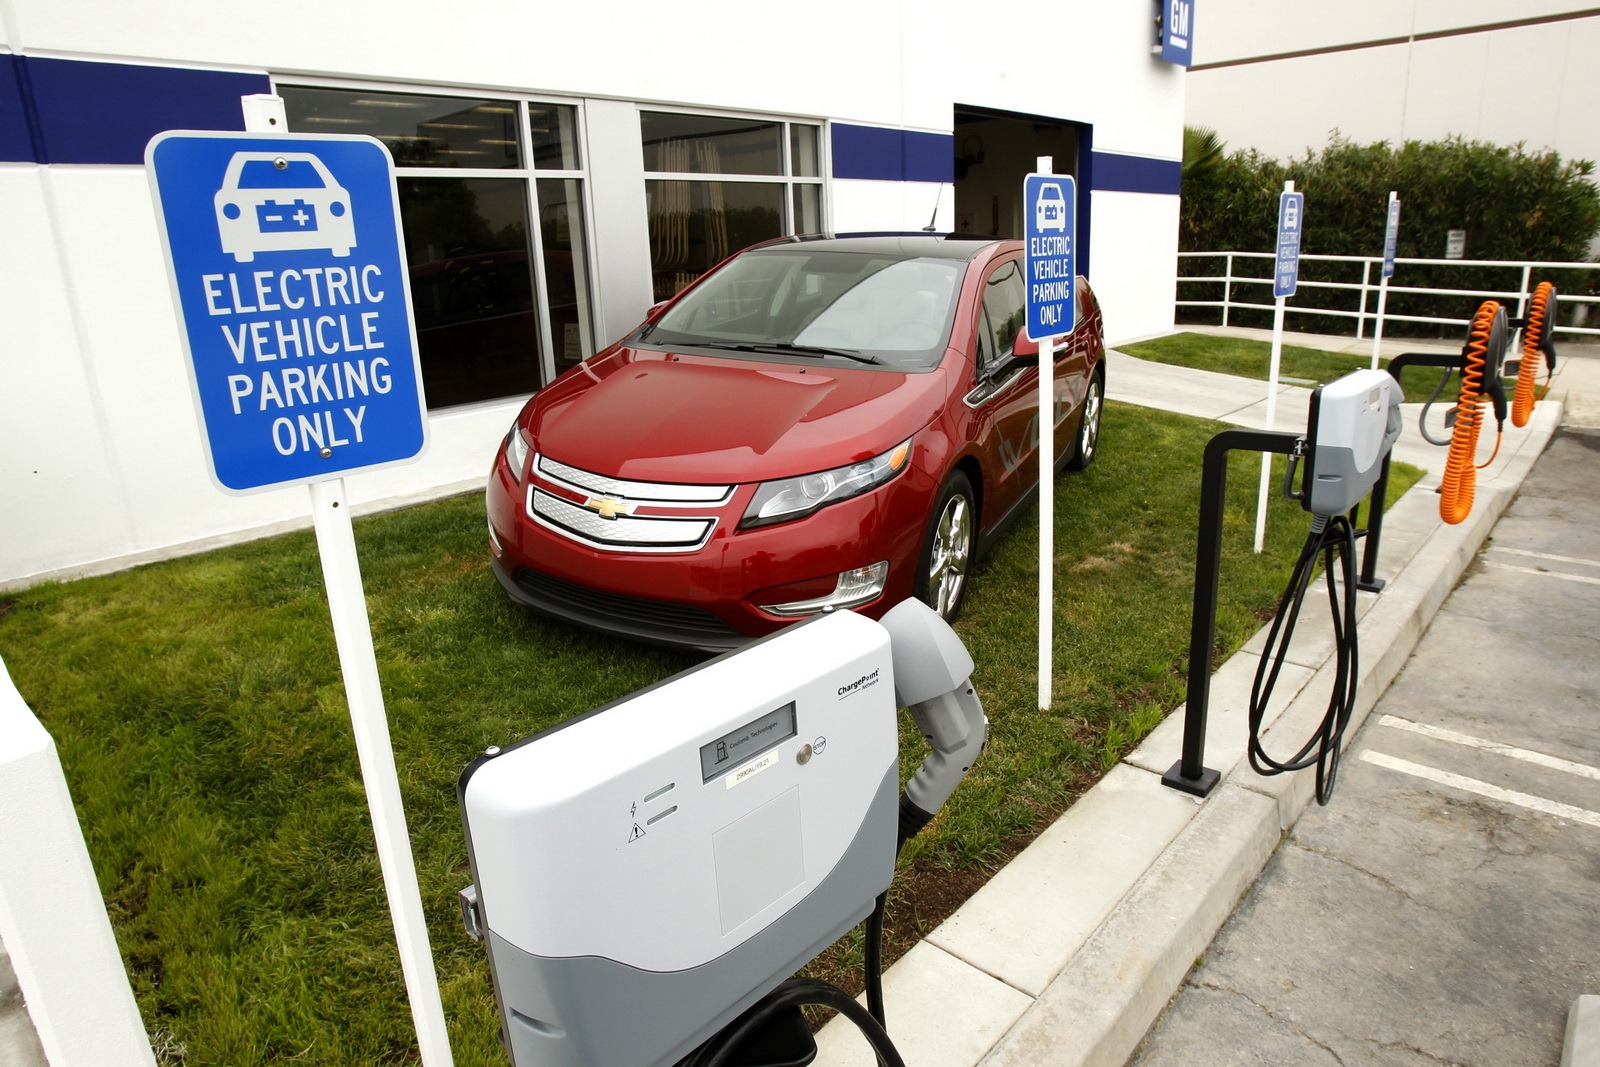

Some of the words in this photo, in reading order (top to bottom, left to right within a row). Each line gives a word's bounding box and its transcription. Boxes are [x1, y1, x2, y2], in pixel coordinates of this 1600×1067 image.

[1171, 0, 1189, 36] GM
[1031, 236, 1070, 257] ELECTRIC
[1033, 259, 1068, 280] VEHICLE
[202, 264, 385, 316] ELECTRIC
[1033, 281, 1069, 303] PARKING
[1040, 304, 1062, 325] ONLY
[221, 312, 385, 364] VEHICLE
[227, 357, 392, 415] PARKING
[272, 405, 367, 456] ONLY
[837, 670, 879, 696] ChargePoint
[750, 721, 778, 738] Technologies
